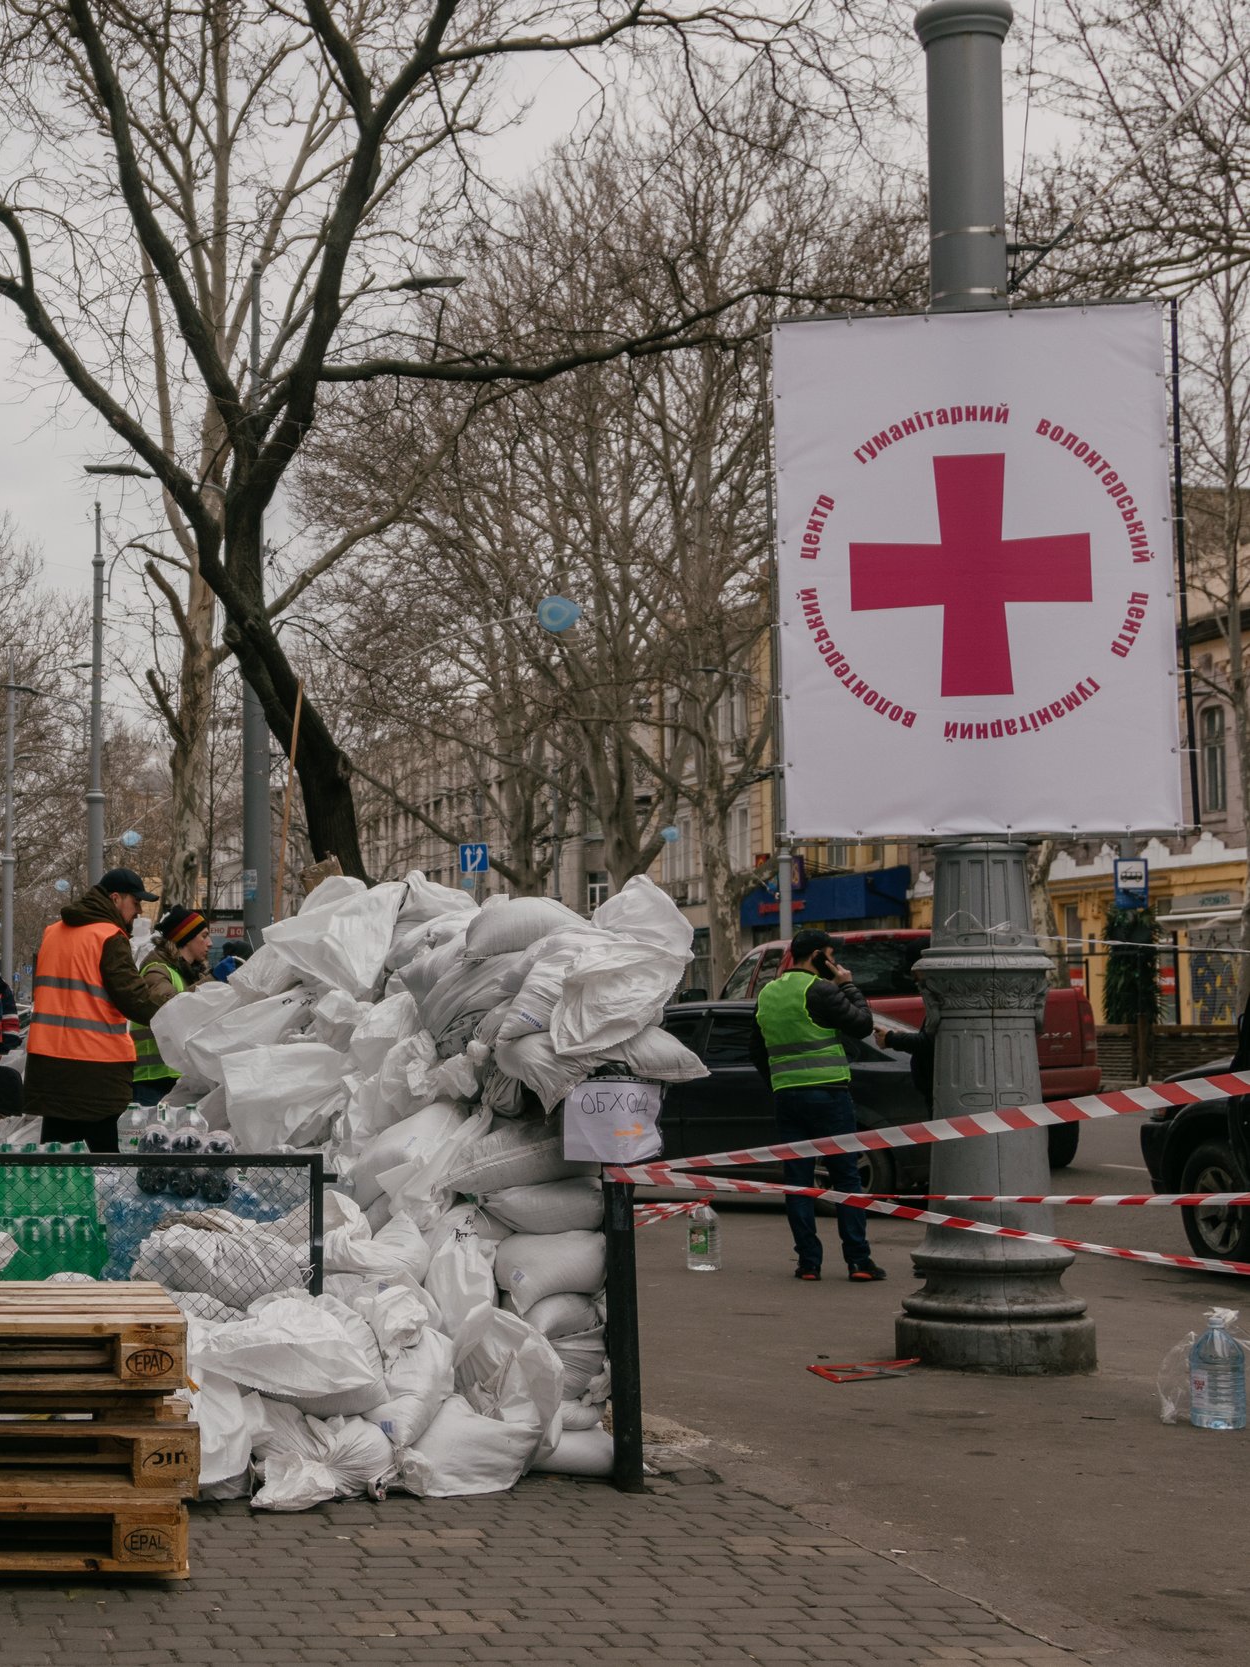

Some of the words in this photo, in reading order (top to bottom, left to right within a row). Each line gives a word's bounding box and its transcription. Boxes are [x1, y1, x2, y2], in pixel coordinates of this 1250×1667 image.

[853, 403, 1010, 464] гуманітарний
[1035, 418, 1155, 563] волонтерський
[801, 494, 835, 560] центр
[796, 587, 917, 728] волонтерський
[1111, 592, 1149, 658] центр
[943, 676, 1101, 743] гуманітарний
[581, 1091, 648, 1114] ОБХОД
[134, 1353, 166, 1371] EPAL
[130, 1534, 167, 1550] EPAL
